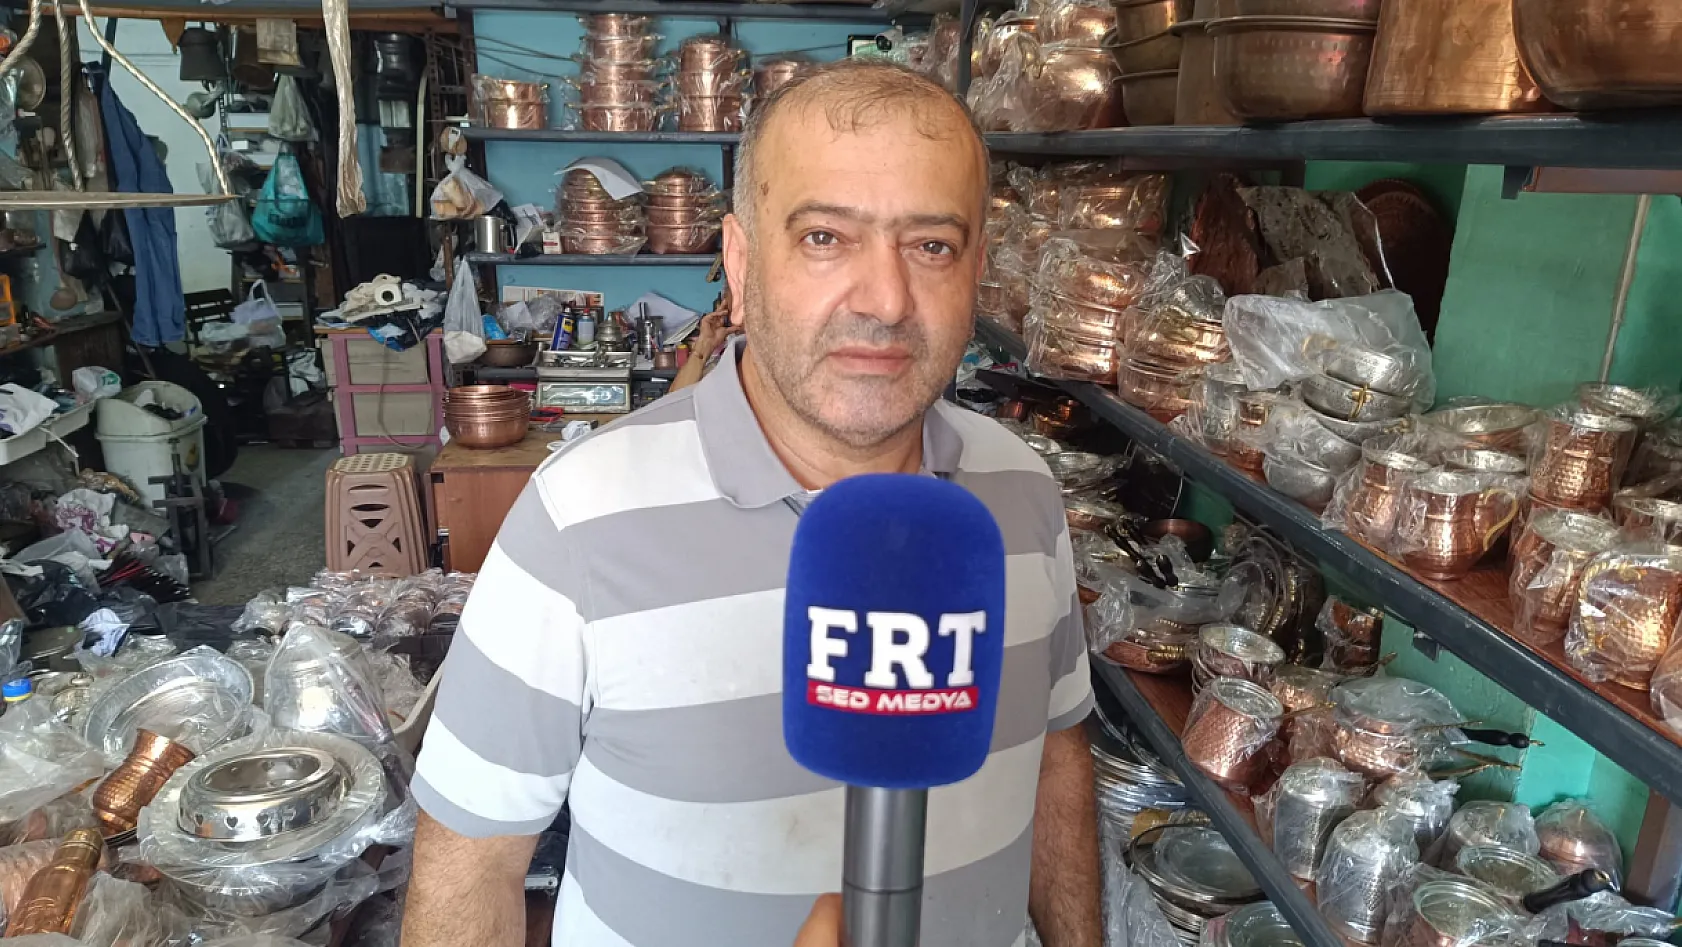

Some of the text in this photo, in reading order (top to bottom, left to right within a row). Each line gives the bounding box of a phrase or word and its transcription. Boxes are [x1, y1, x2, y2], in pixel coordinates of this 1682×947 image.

[807, 606, 986, 688] FRT
[815, 685, 972, 712] SED MEDYA
